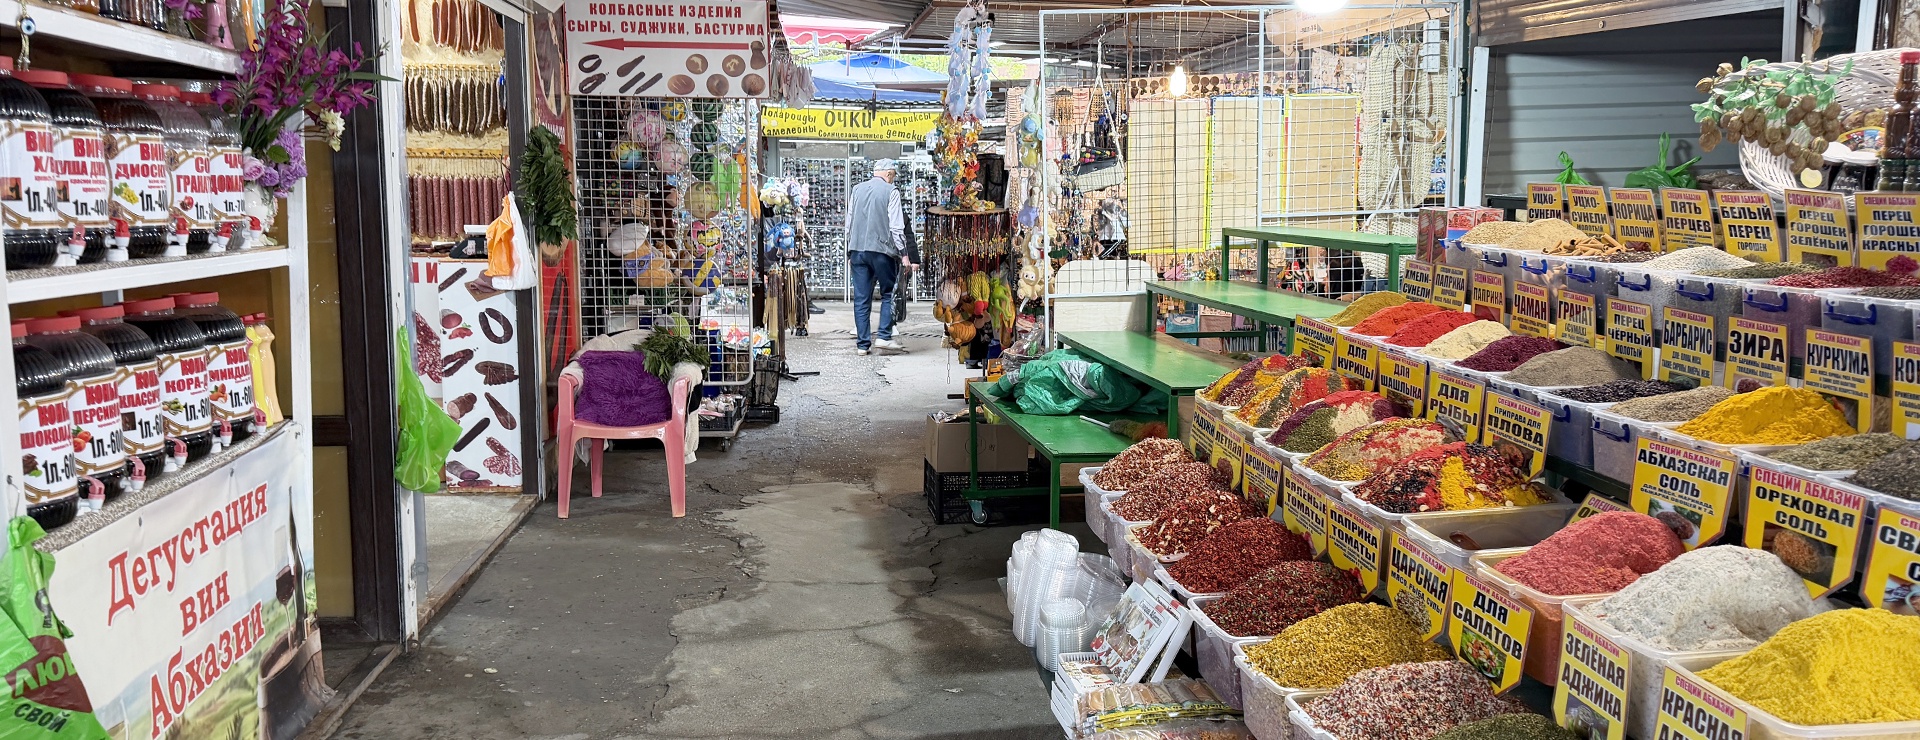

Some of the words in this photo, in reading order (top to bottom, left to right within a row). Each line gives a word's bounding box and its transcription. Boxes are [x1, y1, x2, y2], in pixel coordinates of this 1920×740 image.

[589, 3, 674, 16] КОЛБАСНЫЕ
[680, 5, 741, 18] ИЗДЕЛИЯ
[567, 20, 615, 34] СЫРЫ,
[621, 21, 689, 35] СУДЖУКИ,
[694, 23, 764, 36] БАСТУРМА
[1529, 208, 1561, 219] СУНЕЛИ
[1571, 211, 1608, 224] СУНЕЛИ
[1614, 203, 1655, 223] КОРИЦА
[1671, 201, 1702, 214] ПЯТЬ
[1720, 205, 1772, 220] БЕЛЫЙ
[1799, 210, 1835, 224] ПЕРЕЦ
[1873, 210, 1913, 224] ПЕРЕЦ
[1621, 225, 1654, 238] ПАЛОЧКИ
[1666, 217, 1711, 233] ПЕРЦЕВ
[1728, 225, 1773, 242] ПЕРЕЦ
[1790, 222, 1847, 237] ГОРОШЕК
[1738, 242, 1767, 252] ГОРОШЕК
[1790, 235, 1849, 251] ЗЕЛЁНЫЙ
[1403, 283, 1430, 299] СУНЕЛИ
[1436, 273, 1465, 292] ПАПРИКА
[1473, 287, 1503, 305] ПАПРИКА
[1514, 294, 1547, 321] ЧАМАН
[1558, 300, 1593, 326] ГРАНАТ
[1614, 313, 1645, 332] ПЕРЕЦ
[1608, 327, 1651, 347] ЧЁРНЫЙ
[1663, 320, 1712, 355] БАРБАРИС
[1729, 330, 1785, 363] ЗИРА
[1347, 344, 1367, 360] ДЛЯ
[1615, 343, 1643, 358] МОЛОТЫЙ
[1807, 343, 1870, 376] КУРКУМА
[1337, 356, 1374, 380] КУРИЦЫ
[1394, 363, 1410, 378] ДЛЯ
[1380, 375, 1422, 400] ШАШЛЫКА
[1437, 383, 1469, 403] ДЛЯ
[1429, 398, 1478, 426] РЫБЫ
[1494, 406, 1526, 424] ПРИПРАВА
[1527, 418, 1541, 429] ДЛЯ
[1215, 430, 1242, 457] ЛЕТНЯЯ
[1487, 414, 1544, 447] ПЛОВА
[1245, 452, 1279, 484] АРОМАТНАЯ
[1637, 448, 1730, 486] АБХАЗСКАЯ
[1649, 442, 1681, 456] СПЕЦИИ
[1683, 451, 1721, 468] АБХАЗИИ
[1659, 473, 1700, 498] СОЛЬ
[1755, 468, 1800, 492] СПЕЦИИ
[1804, 481, 1861, 510] АБХАЗИИ
[1287, 491, 1324, 528] ТОМАТЫ
[1755, 485, 1855, 528] ОРЕХОВАЯ
[1330, 508, 1378, 549] ПАПРИКА
[1775, 510, 1828, 539] СОЛЬ
[107, 483, 267, 627] Дегустация
[1331, 524, 1376, 563] ТОМАТЫ
[1398, 536, 1420, 559] СПЕЦИИ
[1421, 549, 1447, 575] АБХАЗИИ
[1392, 547, 1448, 604] ЦАРСКАЯ
[179, 571, 230, 637] вин
[1465, 576, 1491, 593] СПЕЦИИ
[1491, 587, 1521, 613] АБХАЗИИ
[1473, 591, 1508, 625] ДЛЯ
[1452, 601, 1523, 661] САЛАТОВ
[1573, 620, 1594, 641] СПЕЦИИ
[1594, 634, 1620, 658] АБХАЗИИ
[150, 601, 266, 740] Абхазии
[1565, 632, 1625, 691] ЗЕЛЁНАЯ
[1562, 662, 1621, 723] АДЖИКА
[1675, 675, 1702, 699] СПЕЦИИ
[1702, 692, 1734, 719] АБХАЗИИ
[14, 703, 70, 733] СВОЙ
